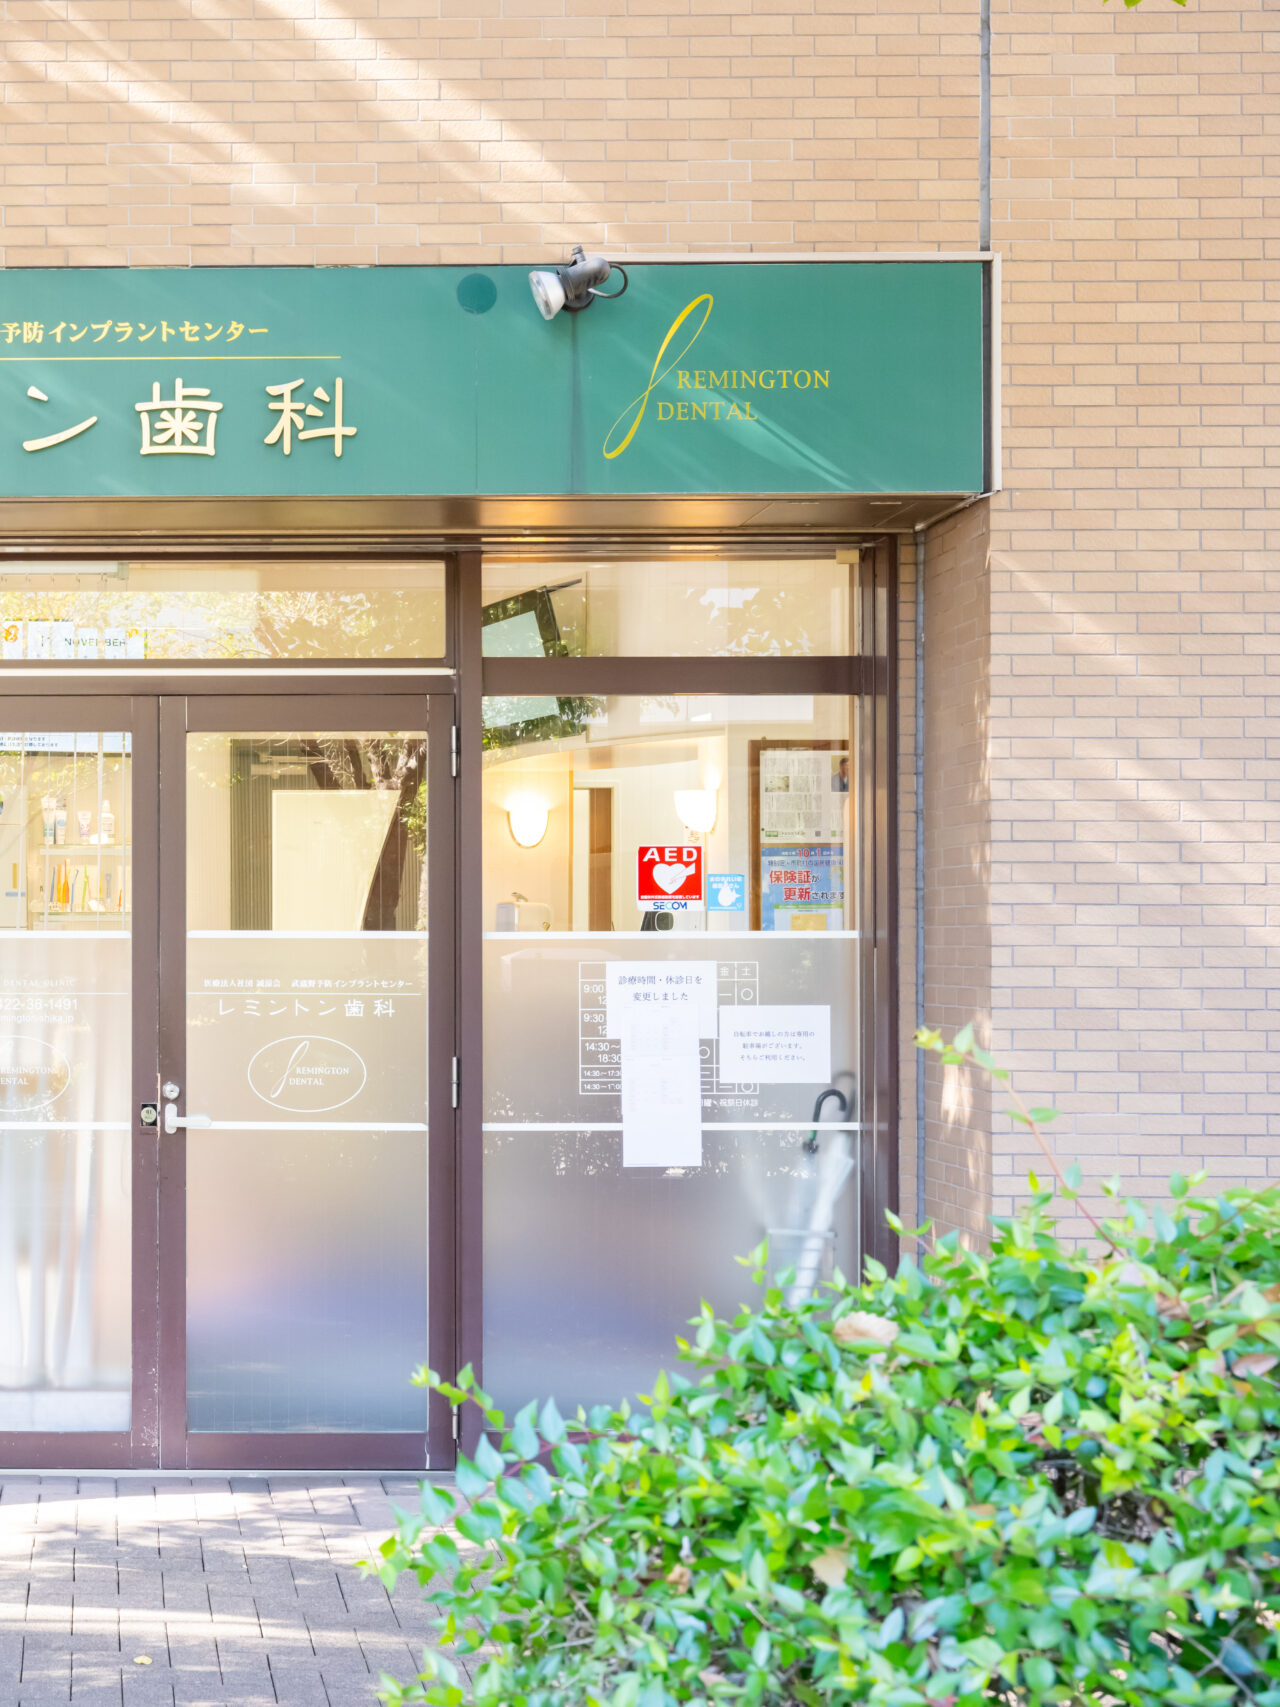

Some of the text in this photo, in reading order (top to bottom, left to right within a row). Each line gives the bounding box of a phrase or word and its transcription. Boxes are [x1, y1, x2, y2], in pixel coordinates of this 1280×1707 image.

[677, 370, 830, 389] REMINGTON
[657, 402, 758, 421] DENTAL
[643, 847, 698, 862] AED
[769, 870, 819, 884] 保険証が
[783, 887, 844, 901] 更新されます
[653, 901, 688, 910] SECOM
[741, 967, 752, 976] 土
[618, 975, 703, 985] 診療時間・休診日を
[633, 992, 688, 1001] 変更しました
[219, 999, 395, 1018] レミントン歯科
[583, 1013, 605, 1023] 9:30
[296, 1066, 350, 1075] REMINGTON
[289, 1077, 325, 1086] DENTAL
